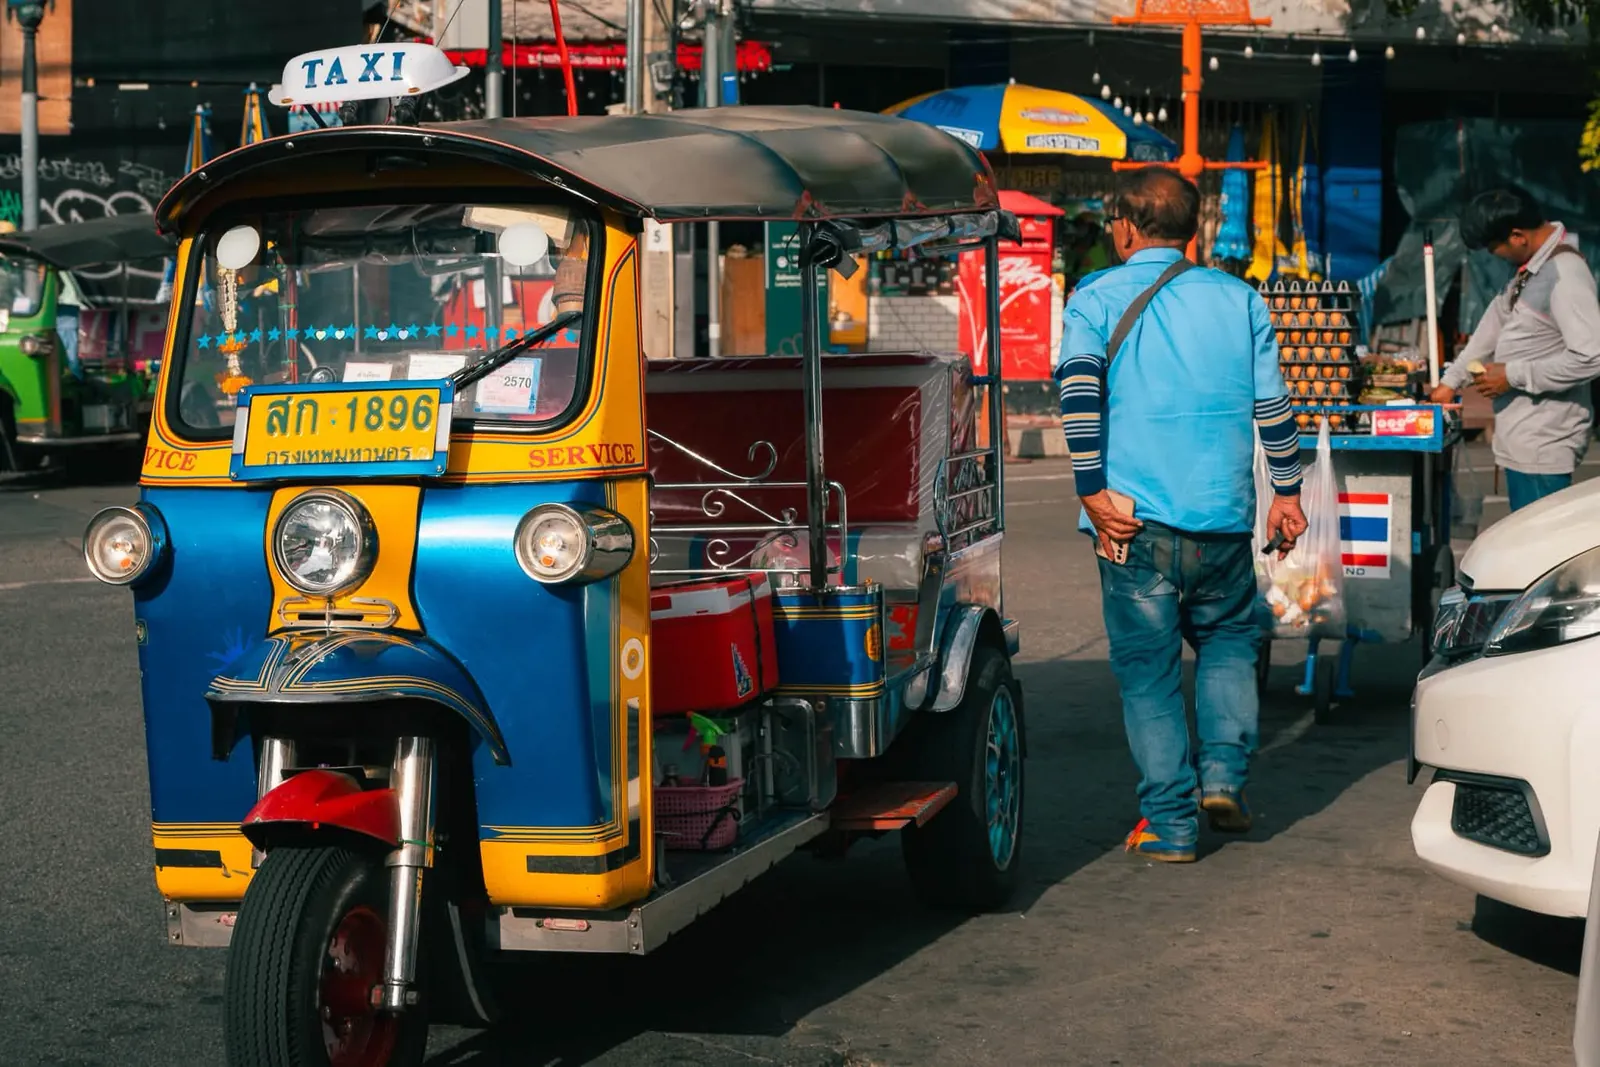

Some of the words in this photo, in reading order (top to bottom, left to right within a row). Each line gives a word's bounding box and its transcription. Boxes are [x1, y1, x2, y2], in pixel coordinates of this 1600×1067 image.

[301, 52, 406, 88] TAXI
[654, 230, 661, 243] 5
[504, 376, 532, 388] 2570
[267, 395, 318, 435] สก
[346, 394, 433, 433] 1896
[528, 443, 636, 468] SERVICE
